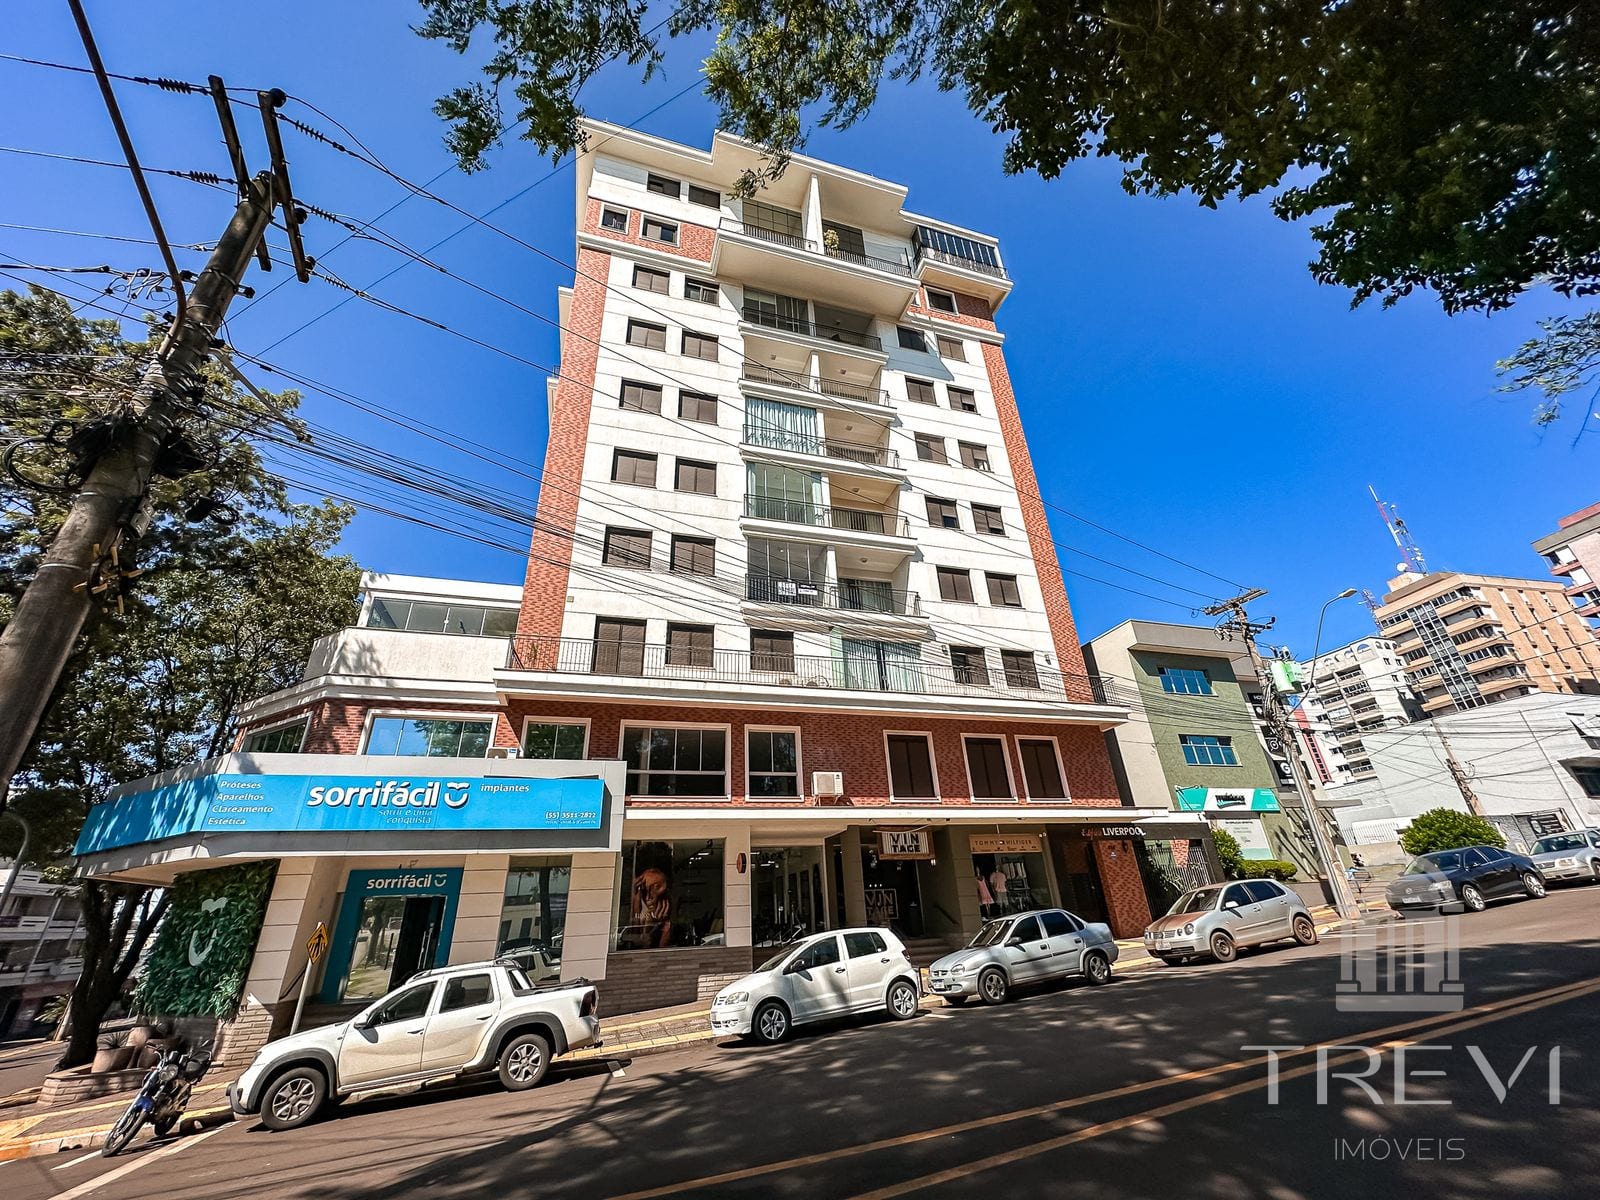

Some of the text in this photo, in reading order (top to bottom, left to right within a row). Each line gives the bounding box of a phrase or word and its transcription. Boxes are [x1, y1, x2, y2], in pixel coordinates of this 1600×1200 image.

[480, 783, 530, 793] implantes
[216, 793, 265, 802] Aparelhos
[307, 780, 440, 808] sorrifácil
[211, 804, 274, 813] Clareamento
[545, 811, 560, 819] (55)
[207, 817, 246, 825] Estética
[386, 816, 432, 824] conquista
[889, 833, 920, 845] VIN
[892, 845, 921, 853] TAGE
[366, 874, 433, 889] sorrifácil
